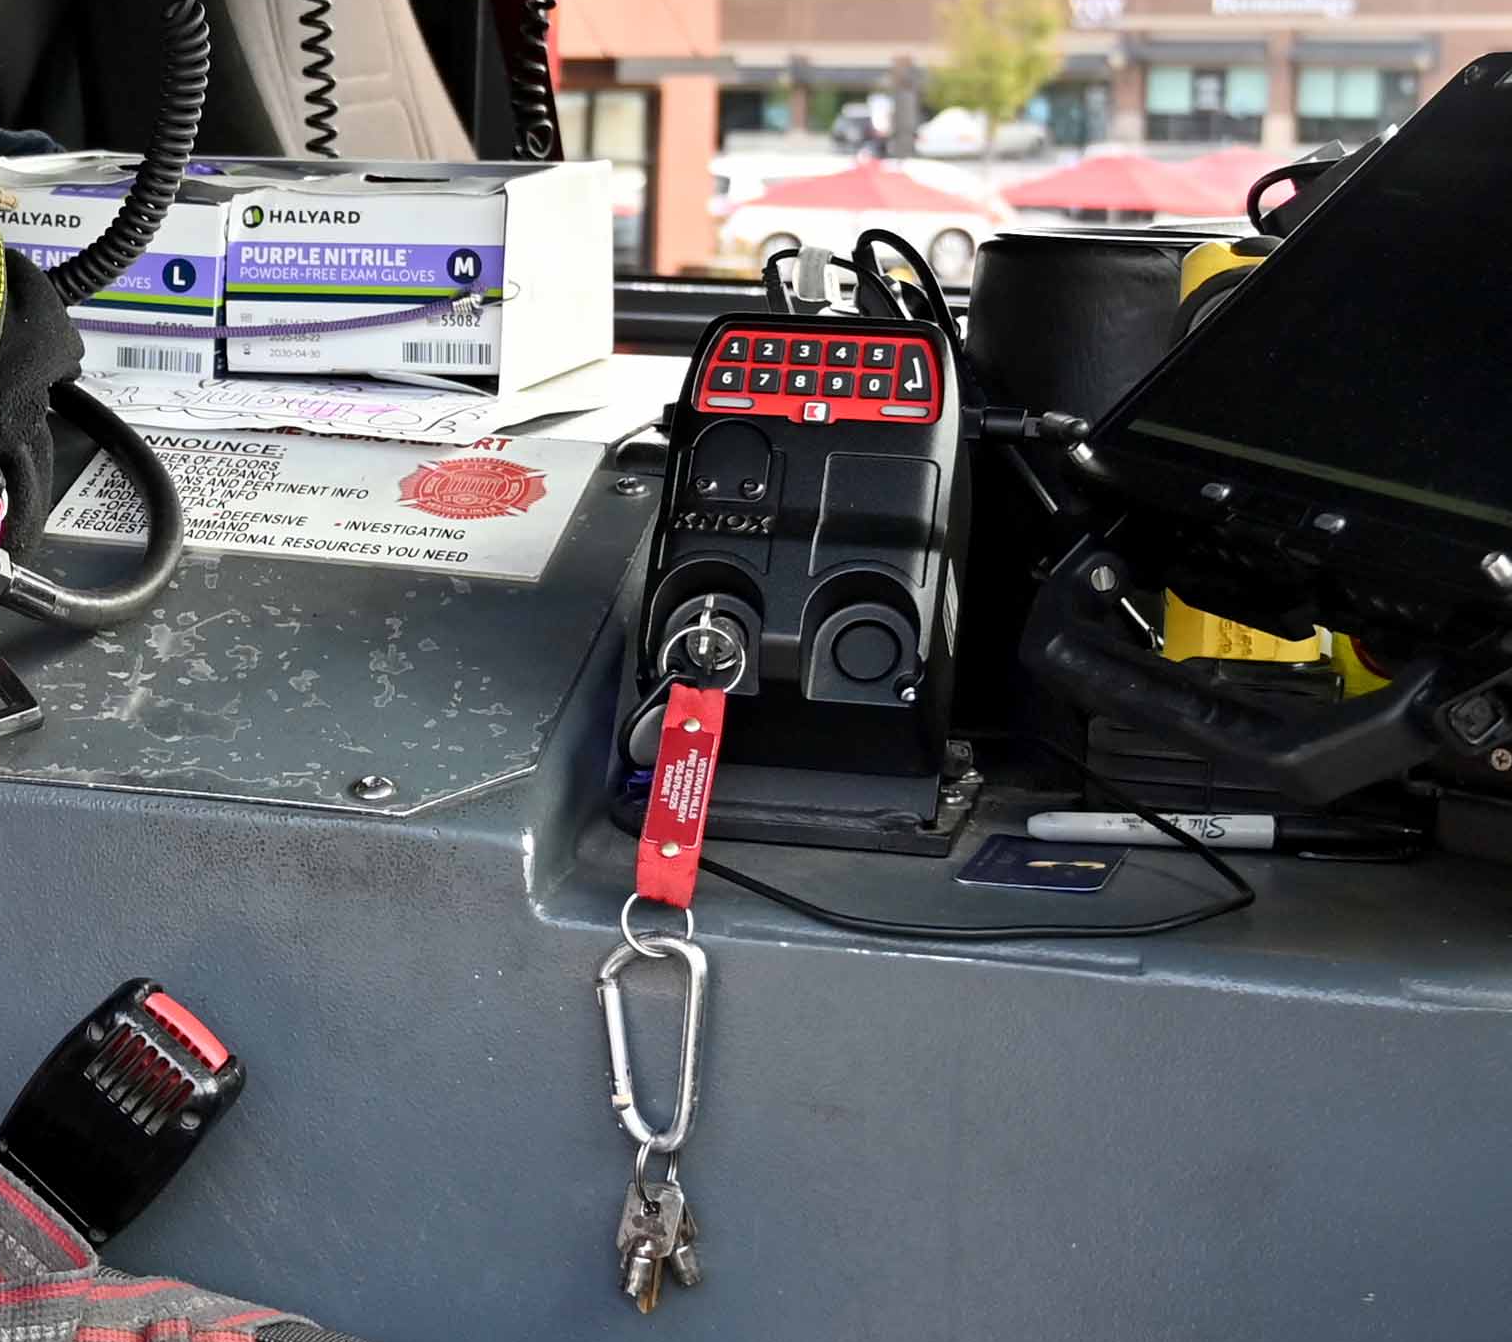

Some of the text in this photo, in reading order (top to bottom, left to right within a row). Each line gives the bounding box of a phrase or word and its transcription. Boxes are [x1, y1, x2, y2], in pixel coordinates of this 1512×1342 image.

[269, 210, 361, 225] HALYARD
[241, 246, 408, 267] PURPLE NITRILE
[453, 256, 475, 277] M
[172, 266, 186, 286] L
[239, 265, 436, 283] POWDER-FREE EXAM GLOVES
[440, 314, 482, 328] 55082
[730, 342, 884, 361] 1 2 3 4 5
[721, 372, 880, 392] 6 7 8 9 0
[142, 434, 288, 457] NNOUNCE:
[184, 465, 280, 481] OCCUPANCY
[216, 455, 281, 472] FLOORS
[78, 486, 90, 498] 5.
[179, 496, 229, 510] TTACK
[207, 477, 240, 490] AND
[243, 480, 329, 497] PERTINENT
[330, 487, 369, 500] INFO
[221, 489, 259, 502] INFO
[62, 506, 250, 532] 6. ESTABLIS OMMAND
[672, 510, 776, 535] KNOX
[55, 516, 470, 564] 7. REQUEST ADDITIONAL RESOURCES YOU NEED
[676, 768, 696, 824] DEPARTMENT
